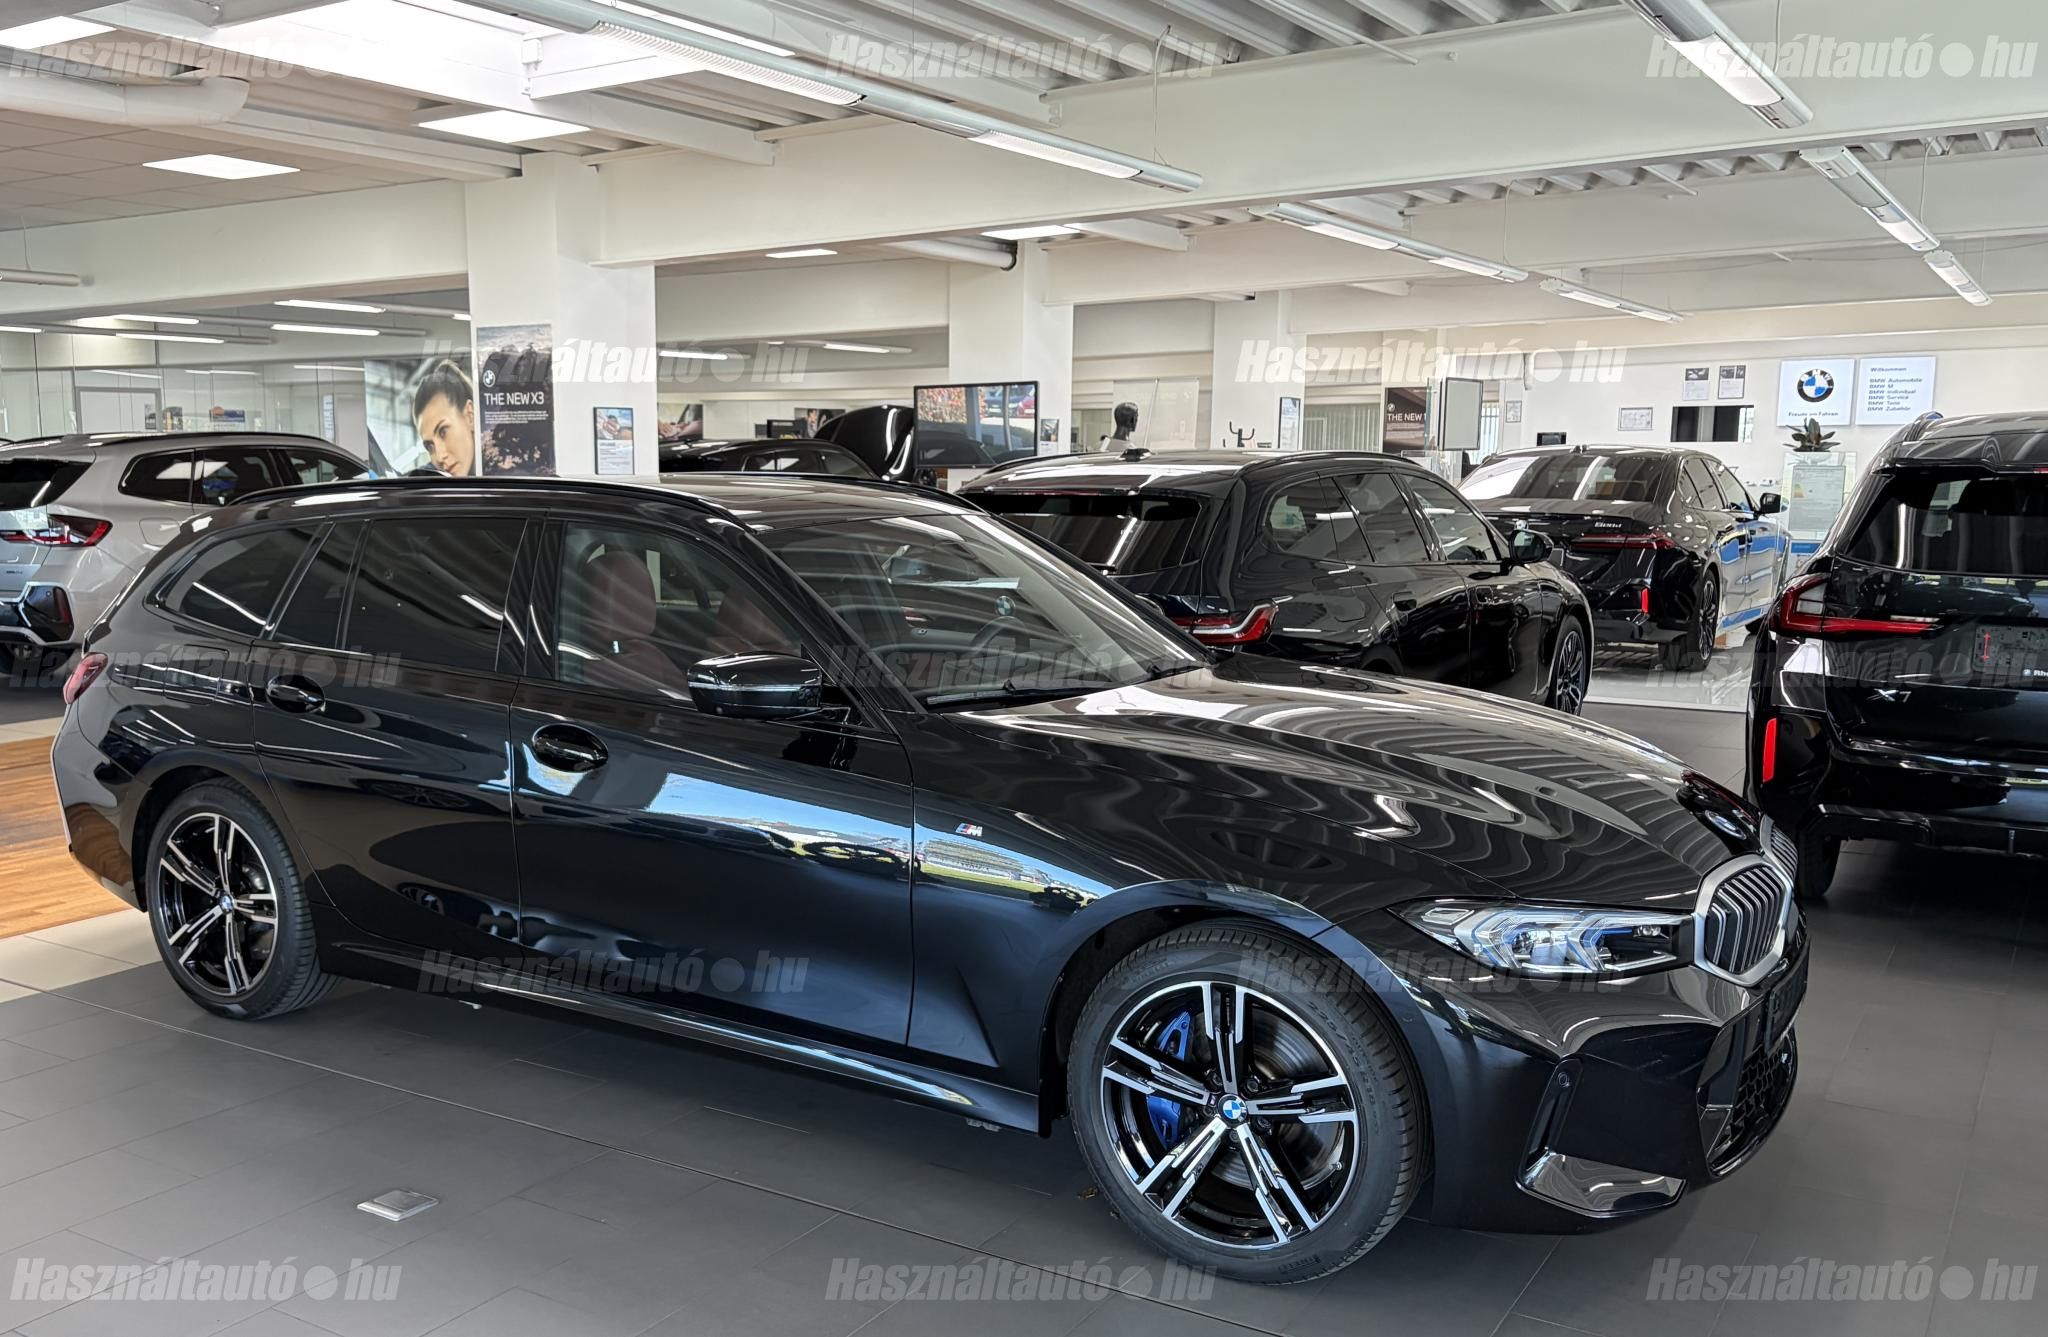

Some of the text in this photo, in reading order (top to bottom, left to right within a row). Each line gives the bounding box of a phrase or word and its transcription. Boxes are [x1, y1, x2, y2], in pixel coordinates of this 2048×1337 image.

[483, 391, 545, 406] THE NEW X3
[1388, 413, 1403, 422] THE
[1404, 412, 1423, 422] NEW
